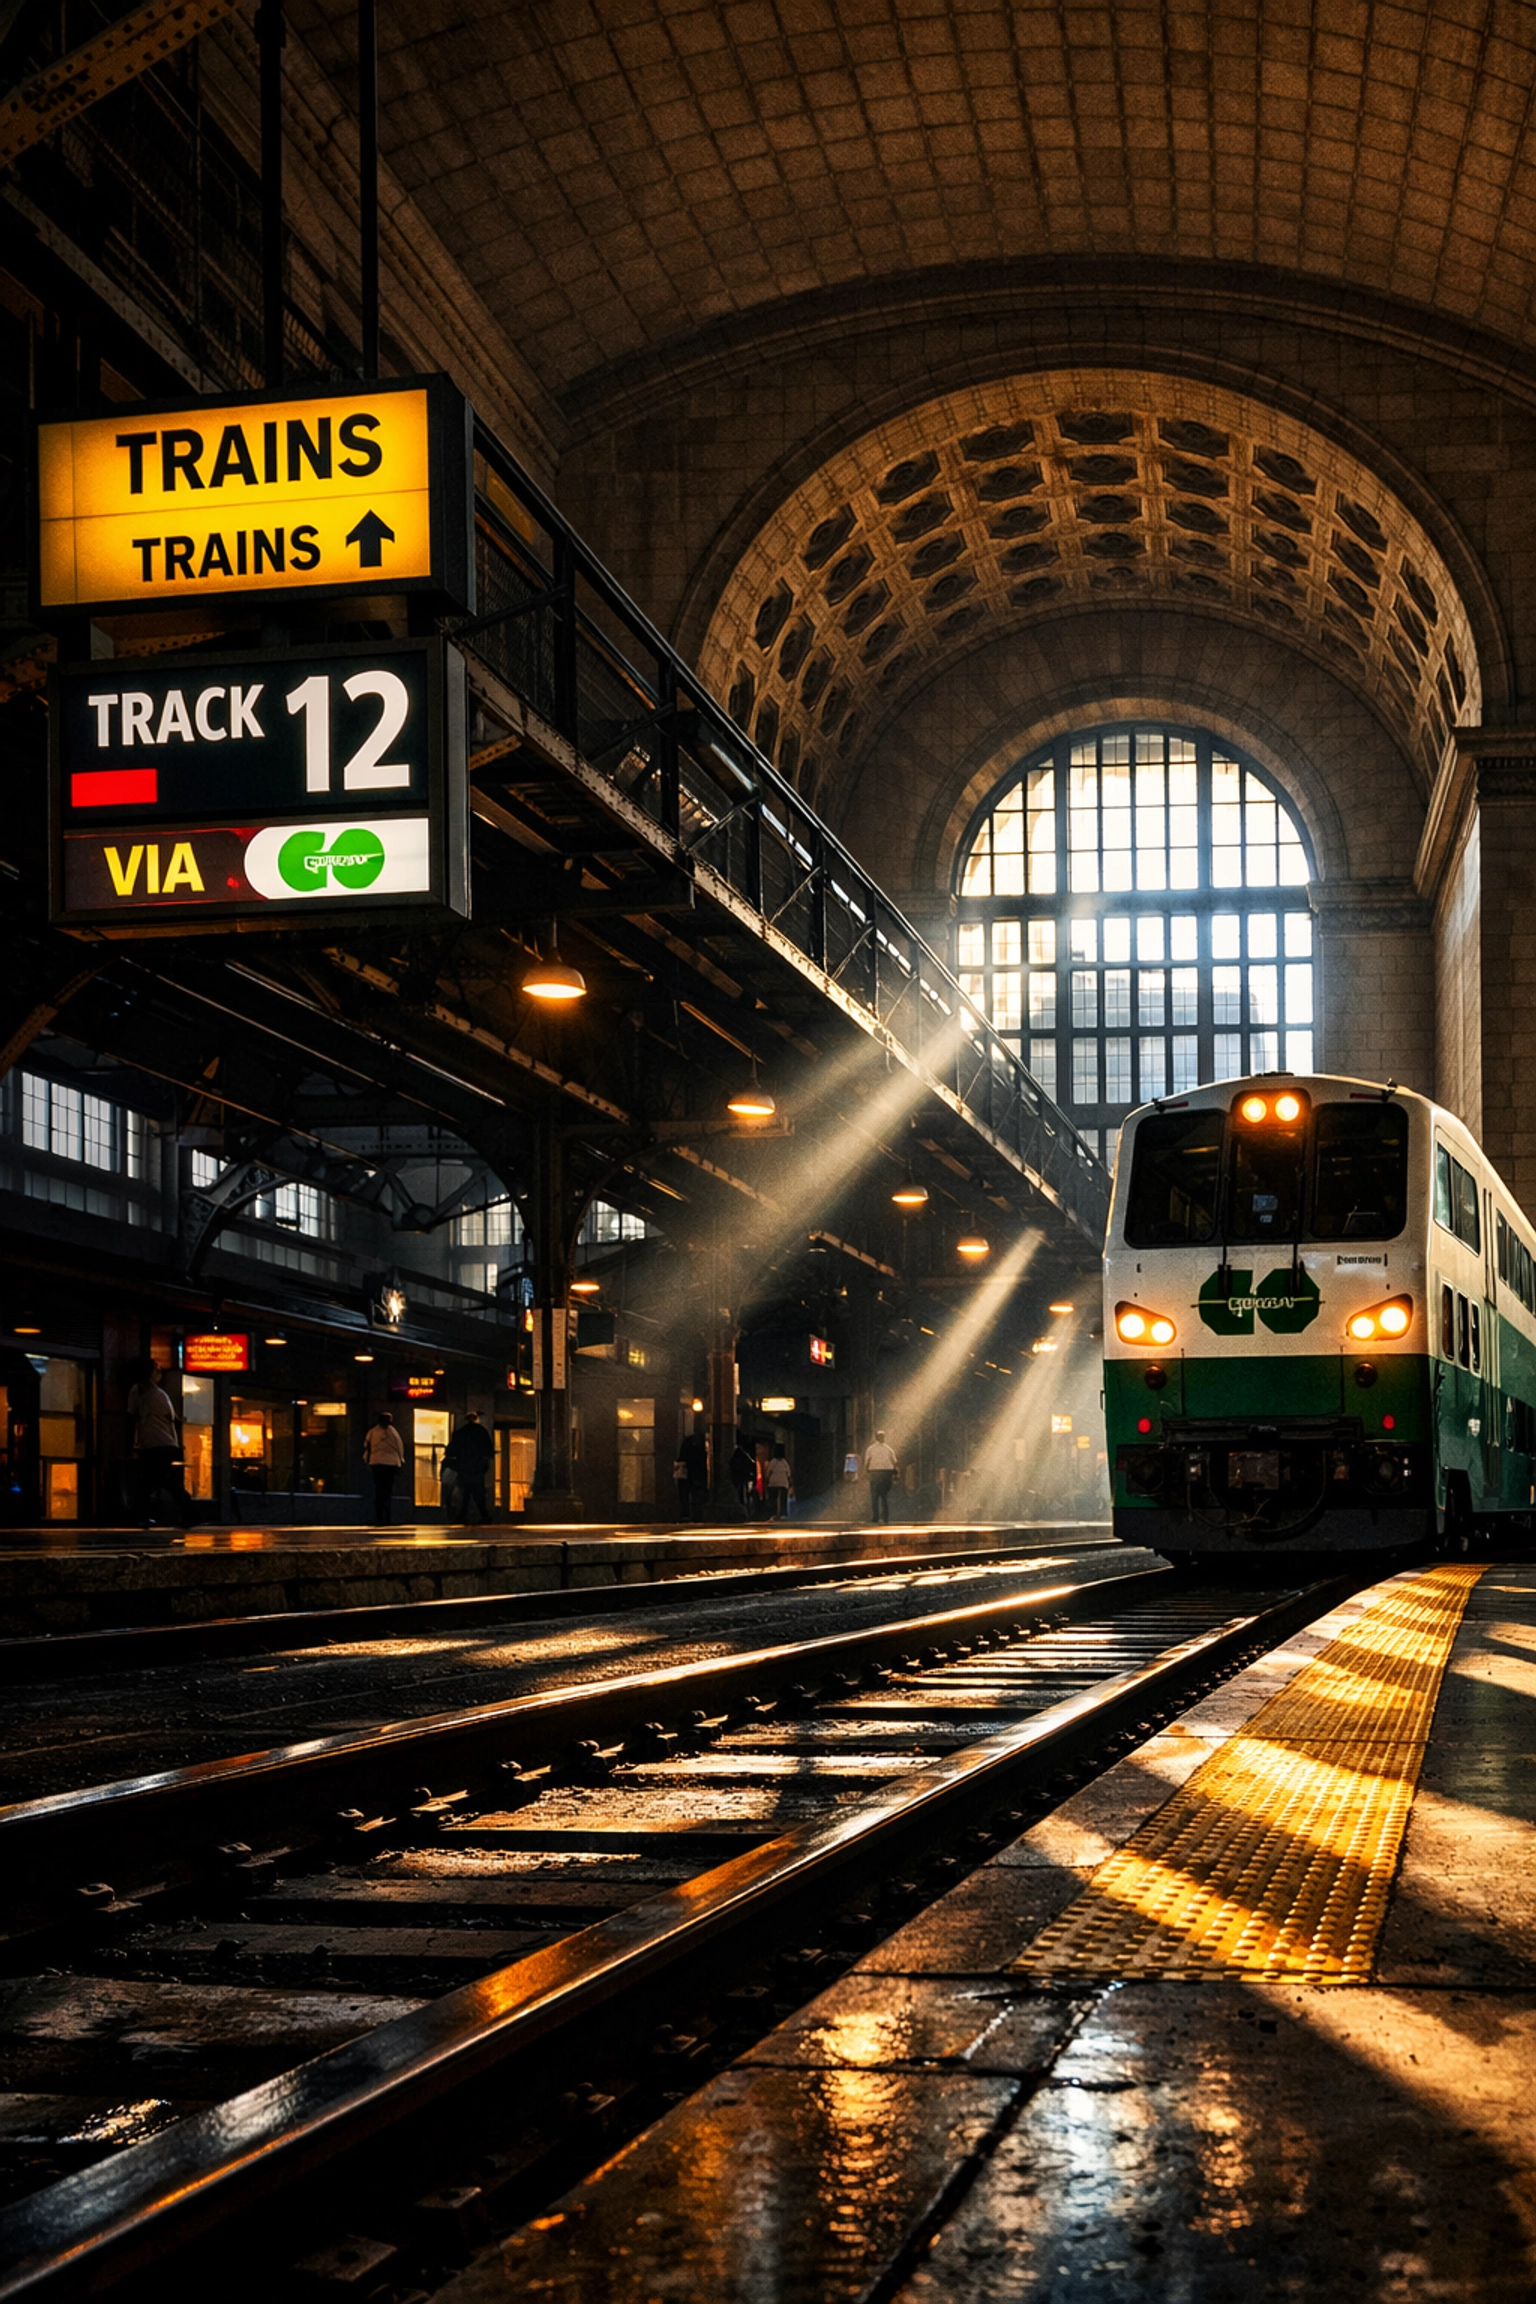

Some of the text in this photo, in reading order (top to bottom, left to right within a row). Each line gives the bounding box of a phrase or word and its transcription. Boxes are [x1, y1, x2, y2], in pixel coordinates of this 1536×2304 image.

[116, 413, 383, 495] TRAINS
[132, 525, 321, 582] TRAINS
[88, 670, 411, 792] TRACK 12
[104, 842, 205, 896] VIA
[278, 828, 385, 892] GO
